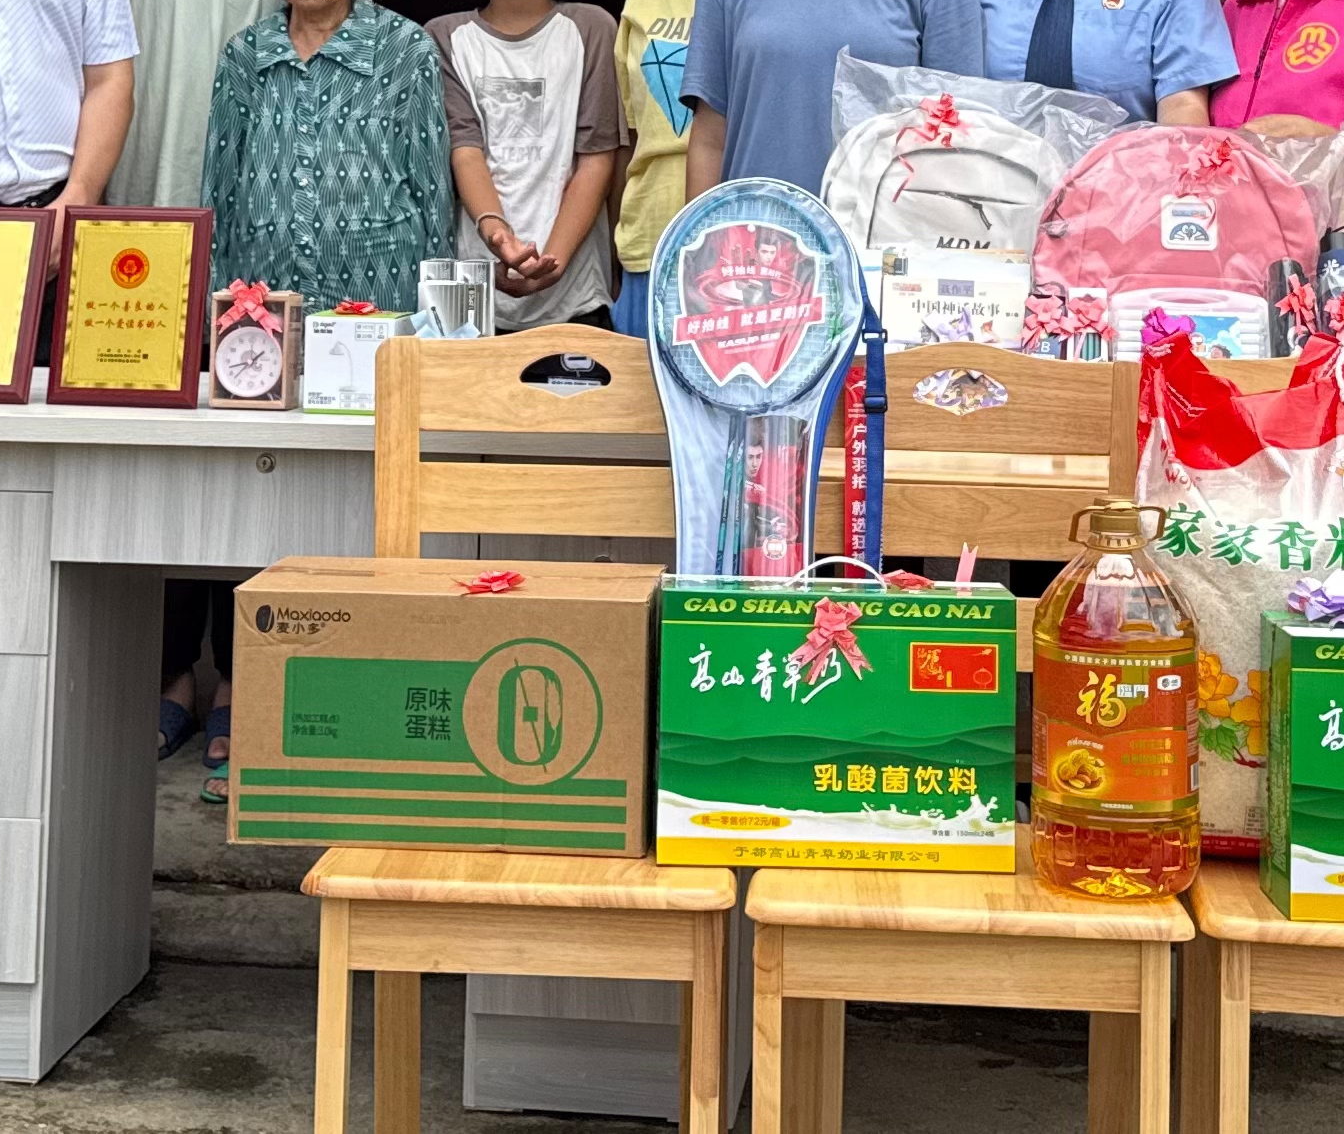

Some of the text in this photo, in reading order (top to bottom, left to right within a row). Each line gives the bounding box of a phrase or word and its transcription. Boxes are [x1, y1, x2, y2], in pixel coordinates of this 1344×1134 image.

[276, 607, 352, 623] Maxiaodo
[683, 597, 738, 613] GAO
[741, 598, 816, 614] SHAN
[888, 602, 942, 618] CAO
[944, 604, 995, 620] NAI
[404, 687, 453, 713] 原味
[404, 714, 452, 741] 蛋糕
[813, 763, 978, 796] 乳酸菌饮料
